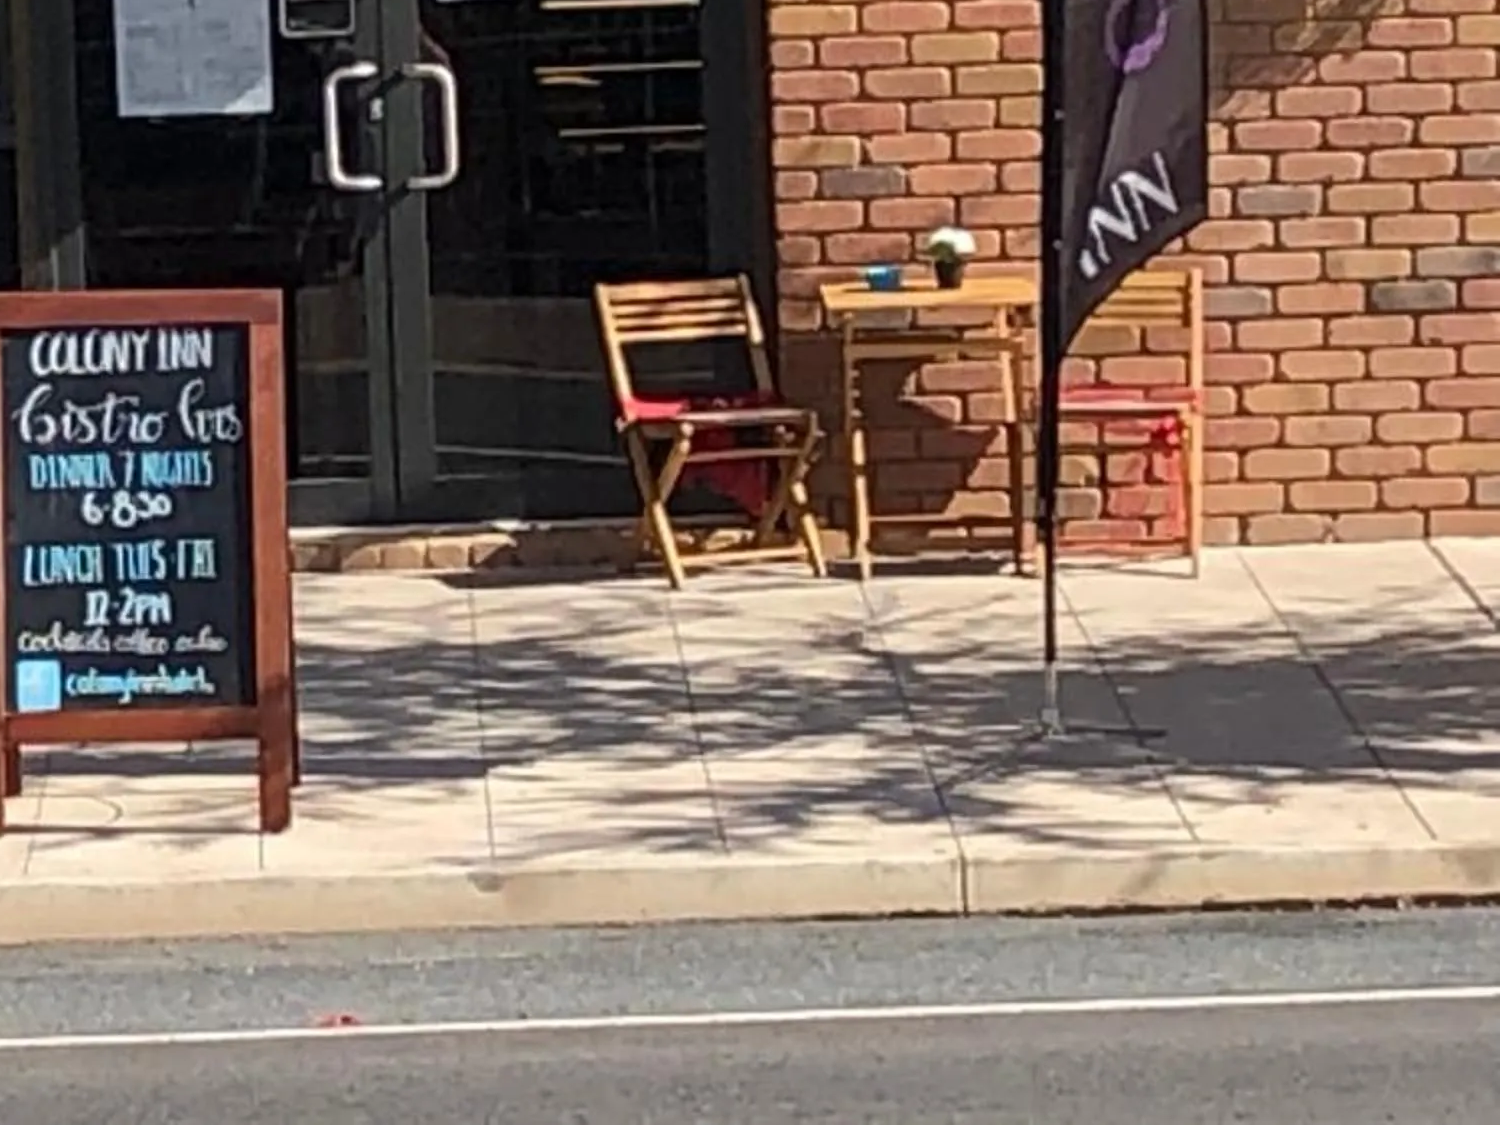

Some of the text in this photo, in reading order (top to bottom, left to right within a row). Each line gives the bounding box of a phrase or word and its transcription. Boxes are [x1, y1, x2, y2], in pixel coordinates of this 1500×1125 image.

[29, 326, 213, 377] COLONY INN
[28, 451, 116, 490] DINNER
[117, 450, 136, 489] 7
[23, 543, 105, 587] LUNCH
